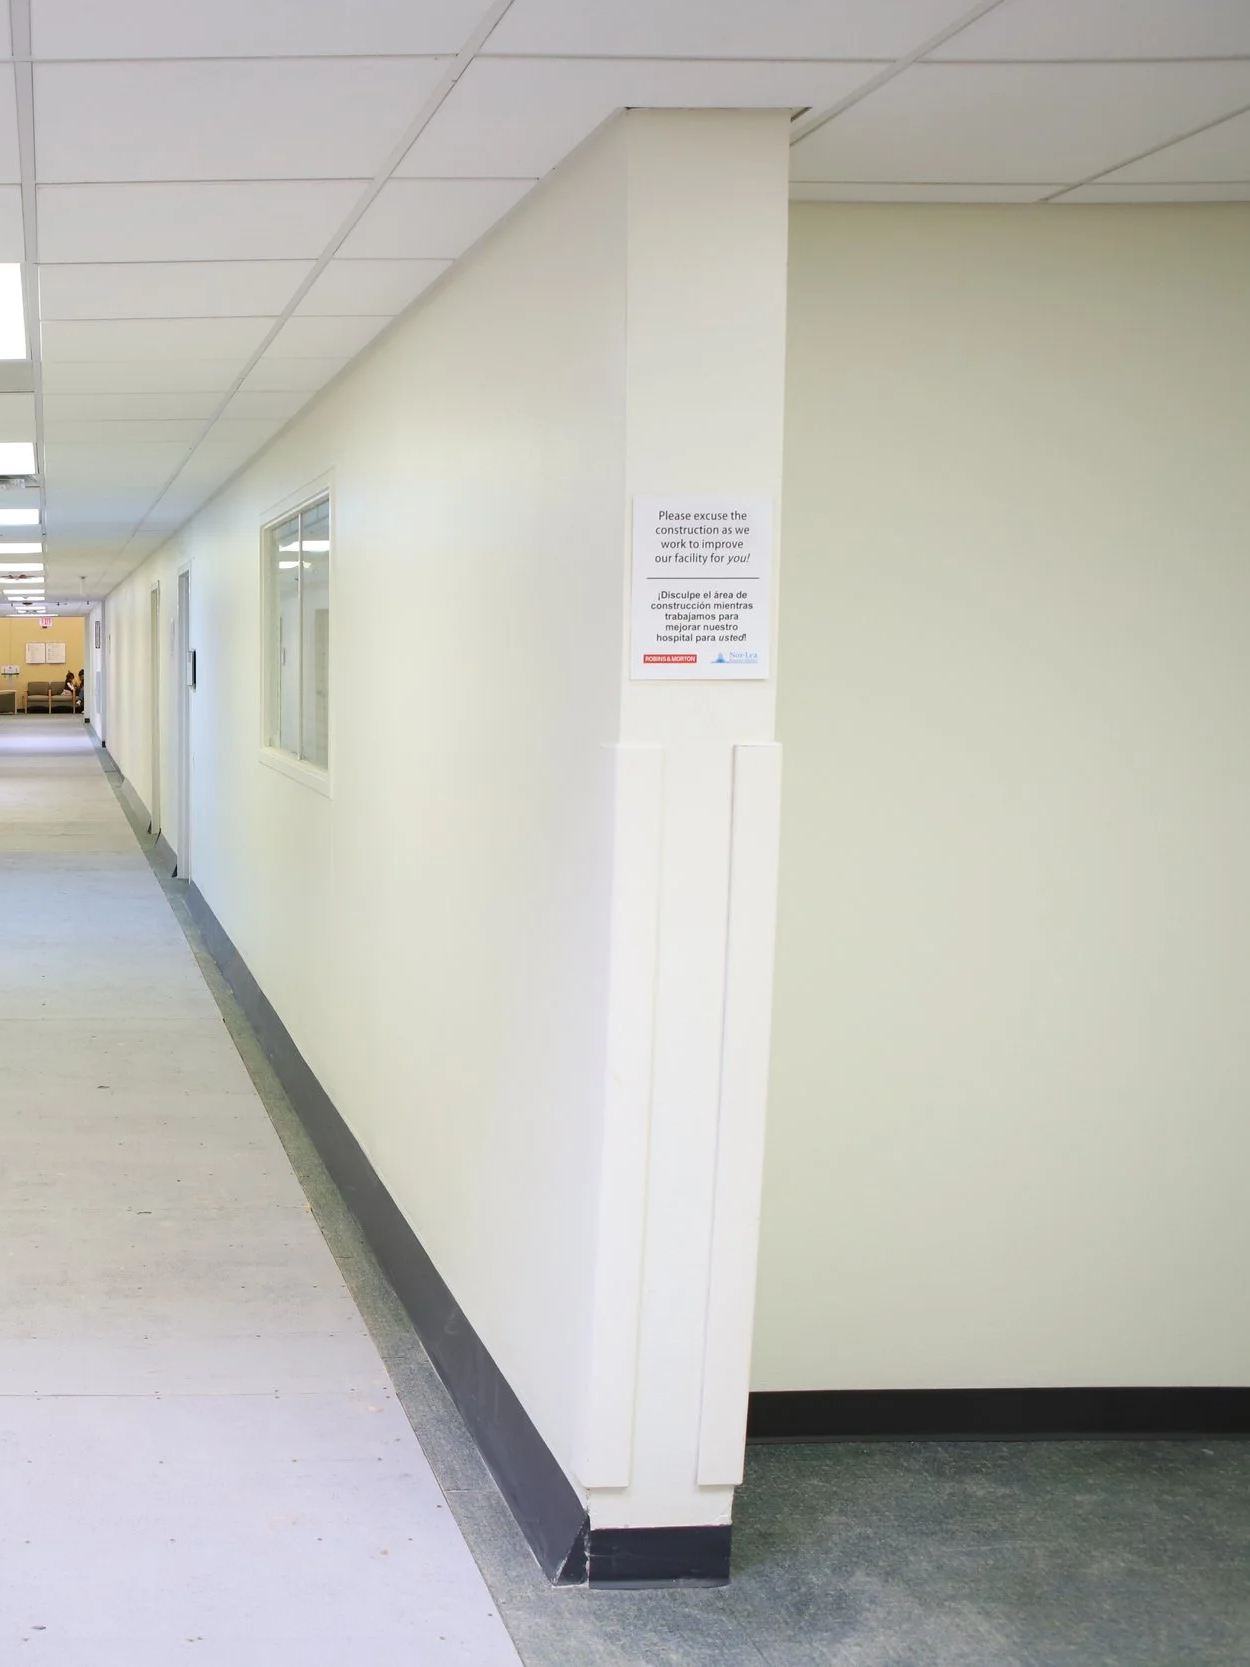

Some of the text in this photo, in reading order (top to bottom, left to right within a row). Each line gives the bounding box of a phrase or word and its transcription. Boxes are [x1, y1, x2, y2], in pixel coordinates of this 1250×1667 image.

[659, 510, 747, 520] Please excuse the
[655, 525, 749, 535] construction as we
[661, 539, 744, 551] work to improve
[655, 553, 750, 565] our facility for you!
[658, 591, 747, 601] ¡Disculpe el área de
[651, 601, 753, 610] construcción mientras
[665, 612, 739, 622] trabajamos para
[665, 623, 738, 633] mejorar nuestro
[656, 633, 746, 643] hospital para usted!
